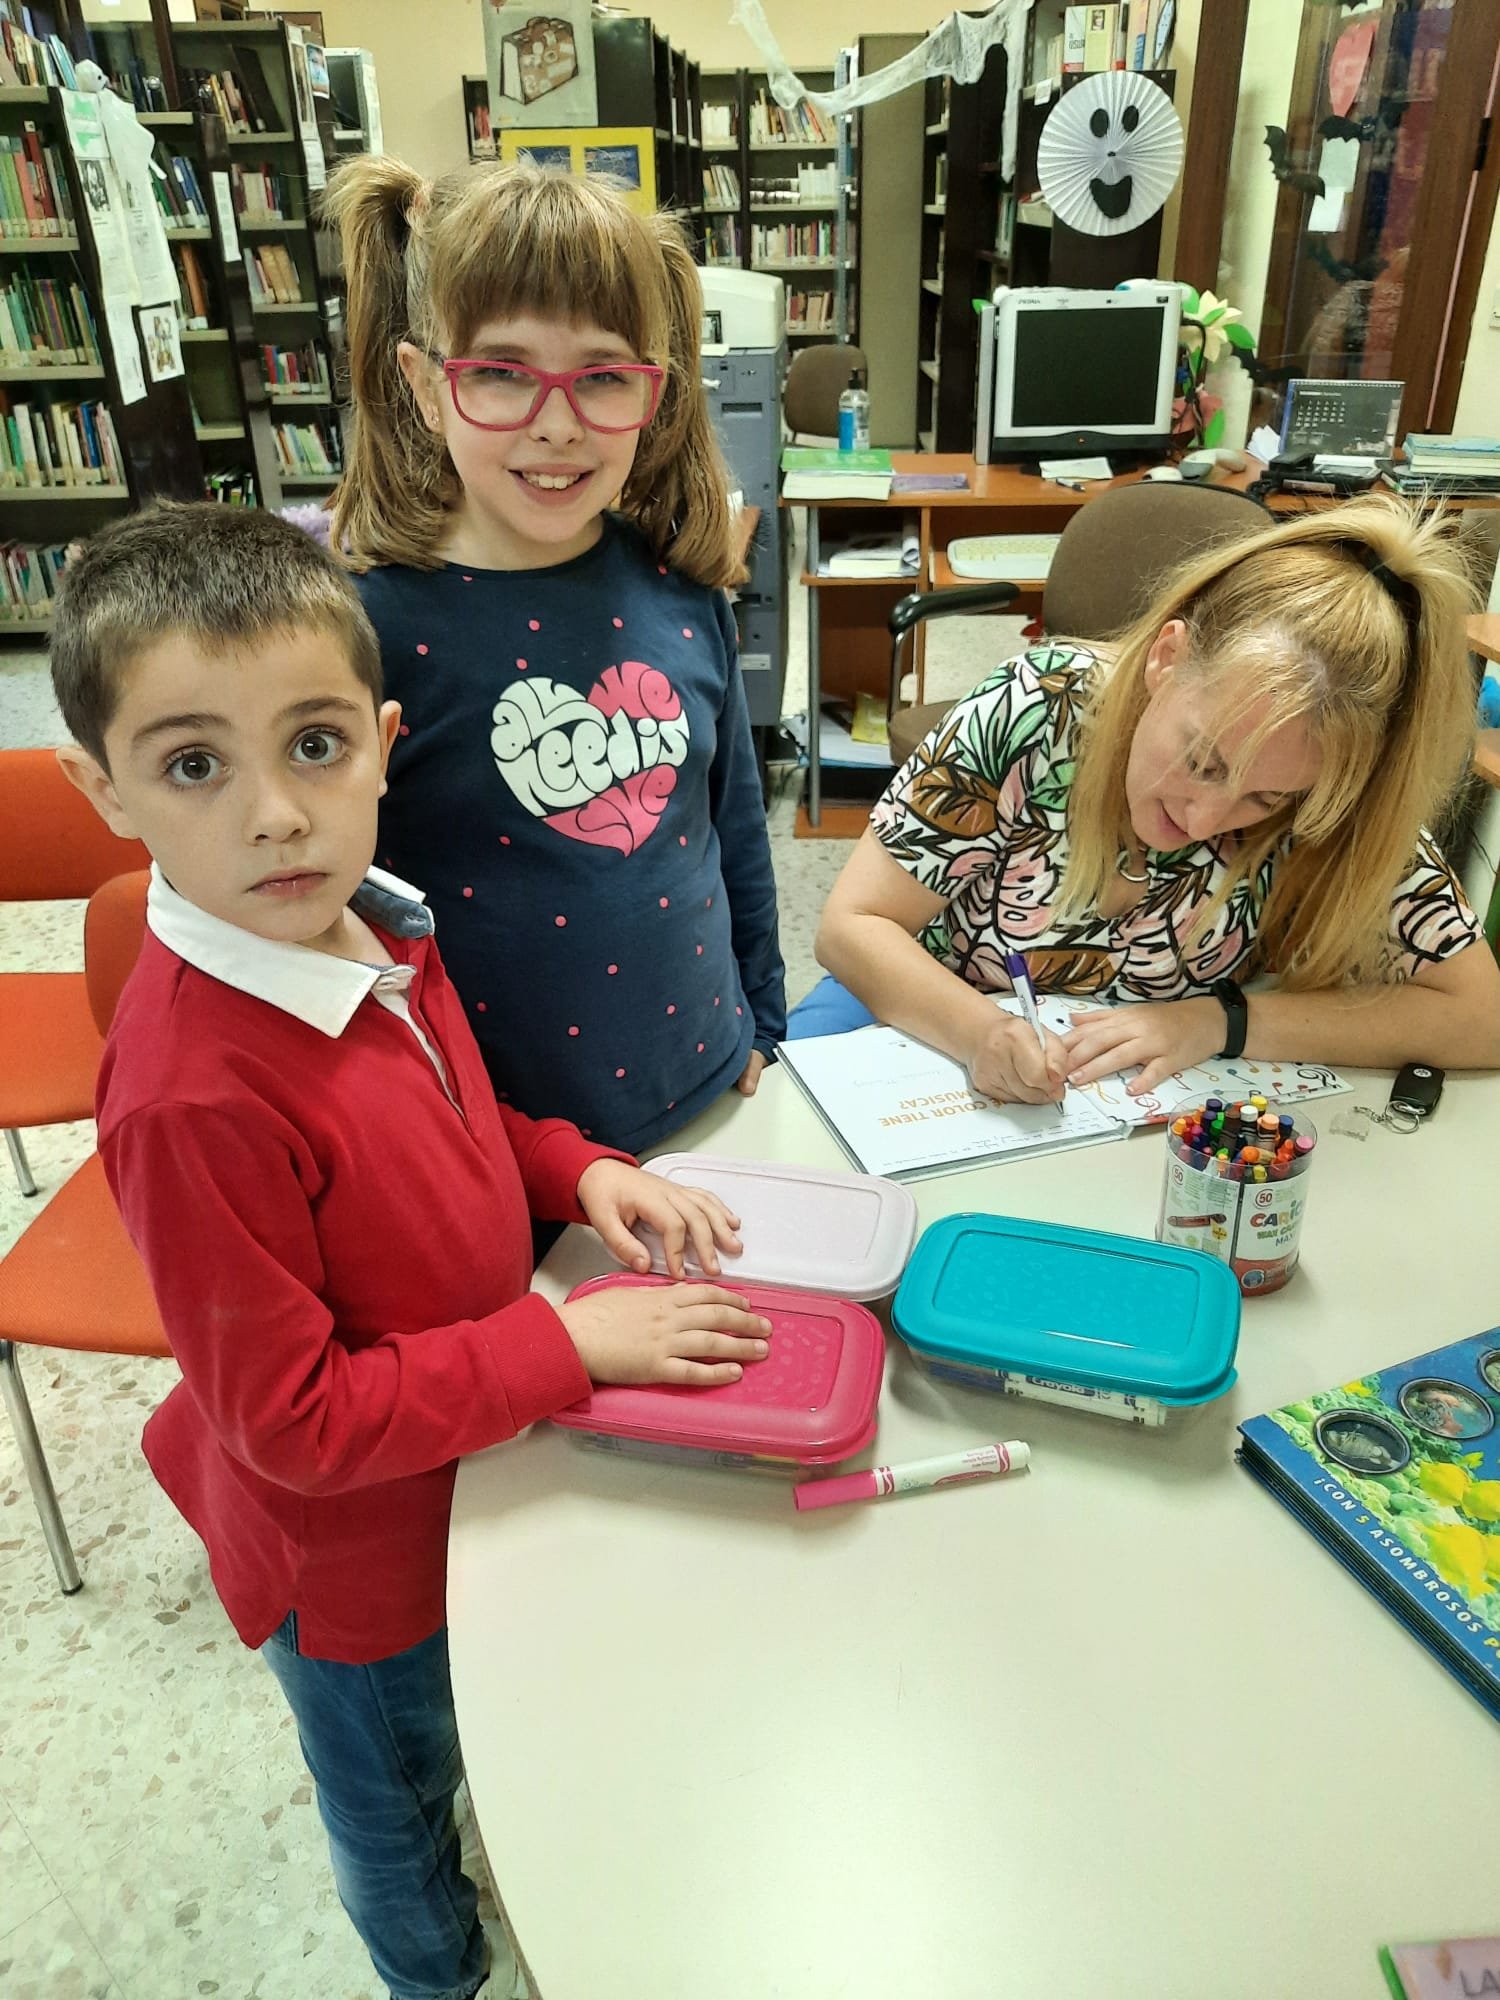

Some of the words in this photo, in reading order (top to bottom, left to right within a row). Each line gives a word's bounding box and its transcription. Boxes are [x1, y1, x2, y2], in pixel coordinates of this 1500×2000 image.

[879, 1110, 930, 1127] TIENE
[932, 1100, 988, 1119] COLOR
[1258, 1192, 1273, 1204] 50
[1356, 1514, 1370, 1525] 5
[1369, 1528, 1483, 1633] ASOMBROSOS
